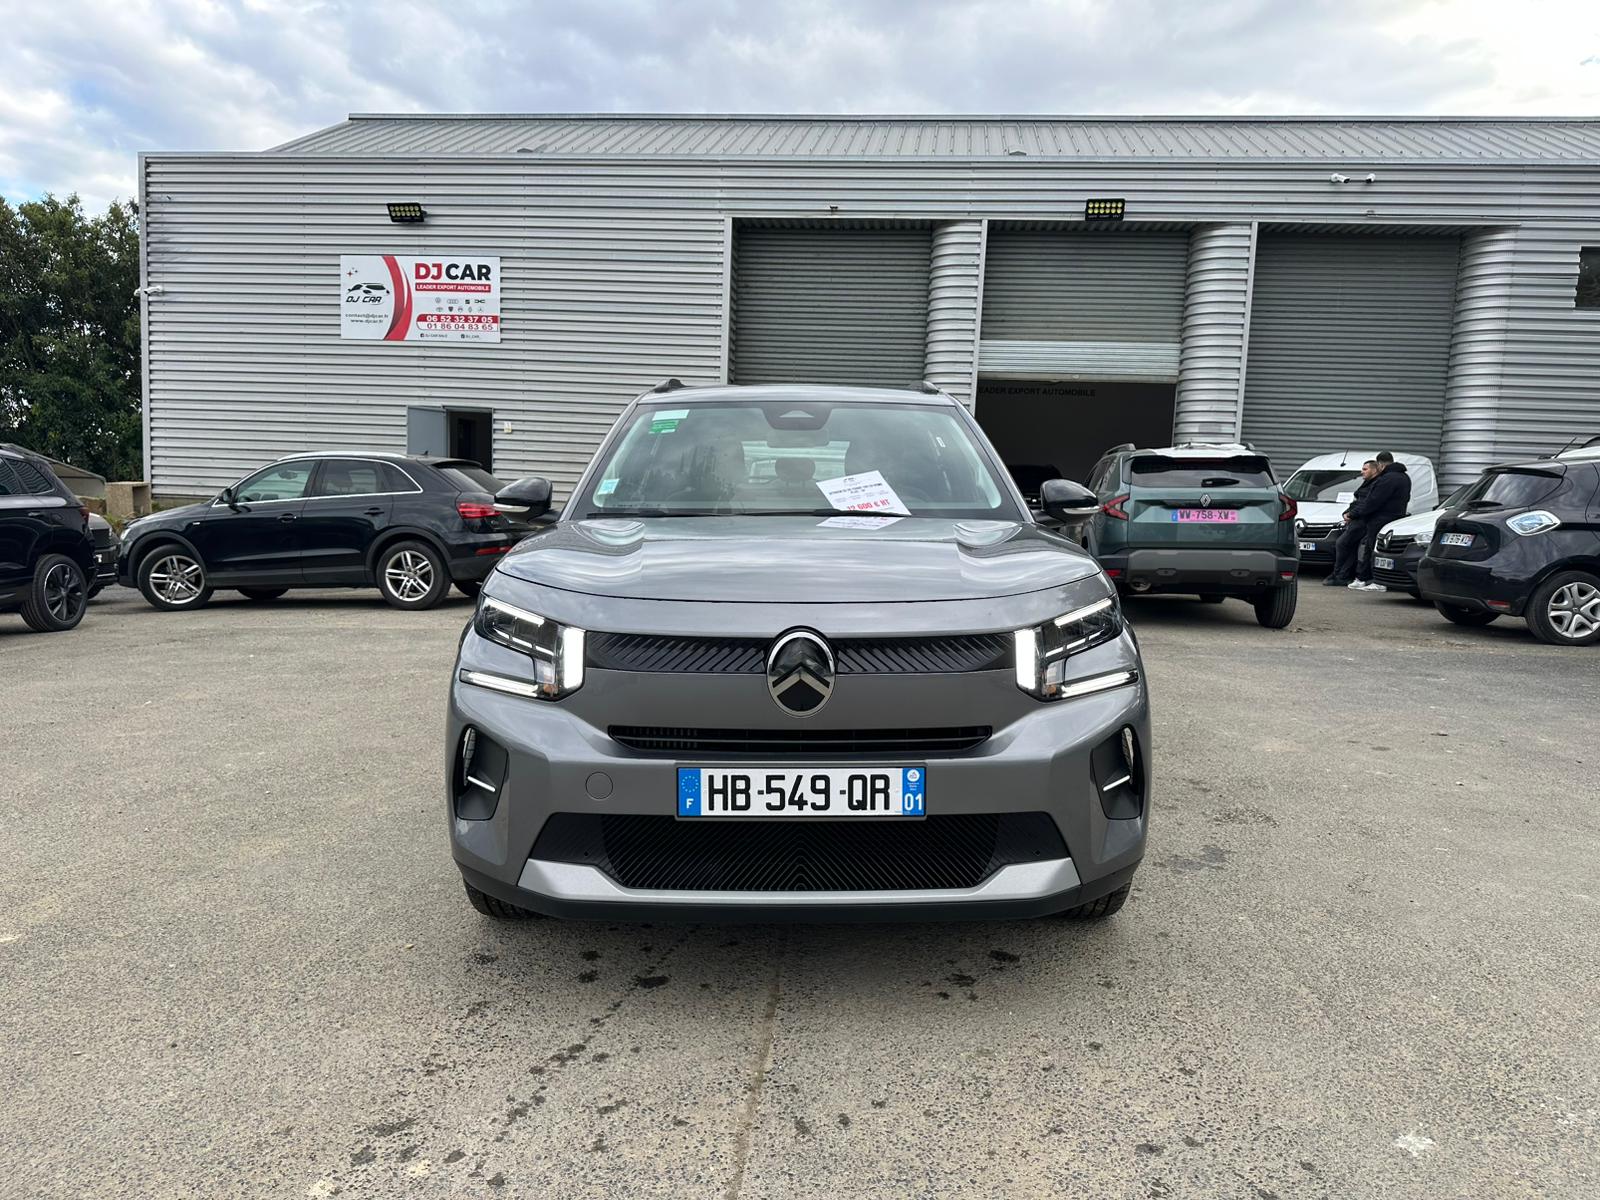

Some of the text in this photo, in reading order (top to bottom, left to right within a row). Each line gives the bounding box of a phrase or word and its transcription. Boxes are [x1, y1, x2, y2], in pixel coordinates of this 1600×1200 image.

[415, 263, 491, 281] DJ CAR
[1008, 387, 1040, 395] EXPORT
[1042, 388, 1096, 397] AUTOMOBILE
[686, 798, 694, 809] F
[904, 793, 923, 811] 01
